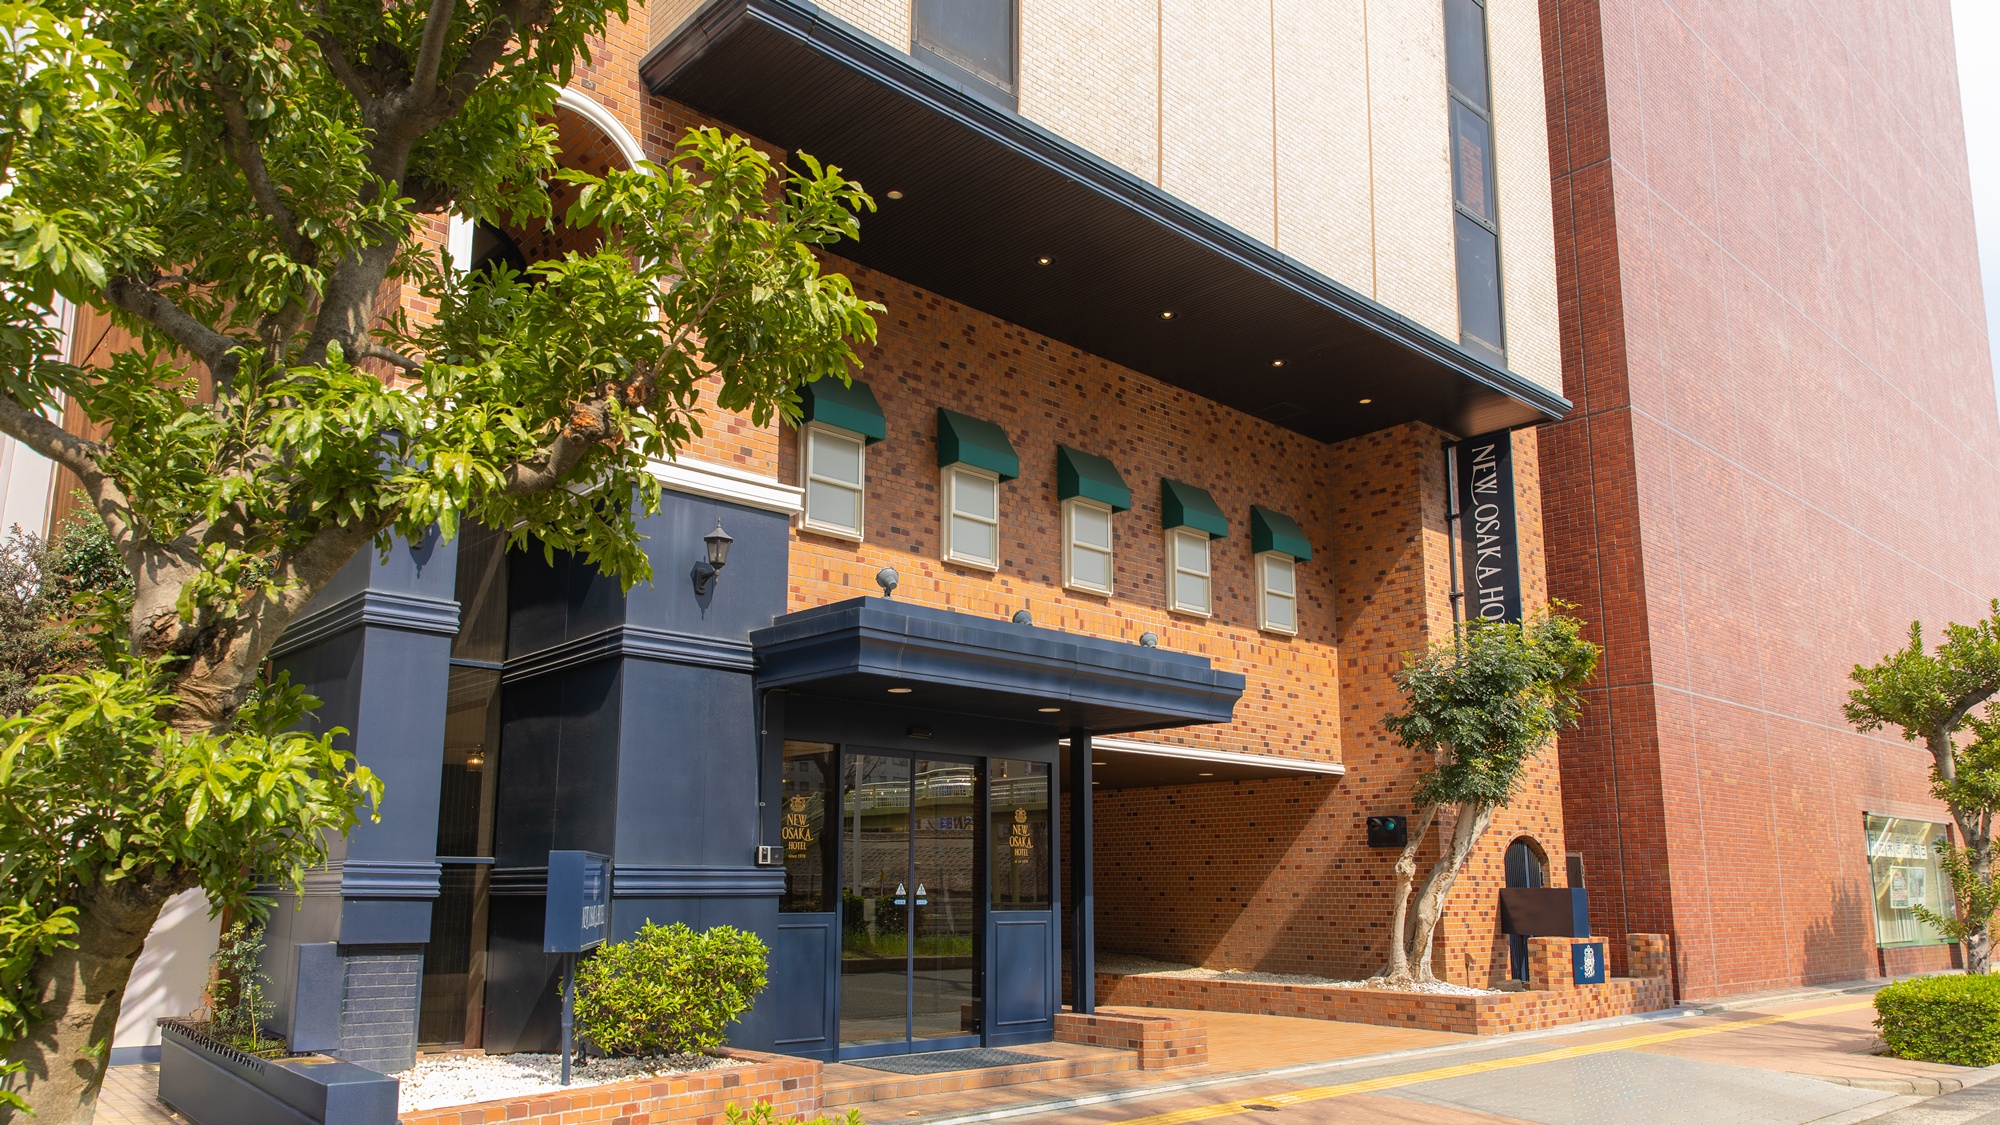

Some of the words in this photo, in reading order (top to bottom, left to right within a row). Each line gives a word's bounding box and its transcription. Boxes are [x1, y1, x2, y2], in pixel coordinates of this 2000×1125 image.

[1471, 443, 1498, 506] NEW
[1475, 503, 1502, 588] OSAKA
[787, 813, 810, 828] NEW
[781, 826, 814, 842] OSAKA
[1012, 824, 1030, 837] NEW
[788, 841, 807, 851] HOTEL
[1009, 835, 1034, 849] OSAKA
[1014, 848, 1029, 857] HOTEL
